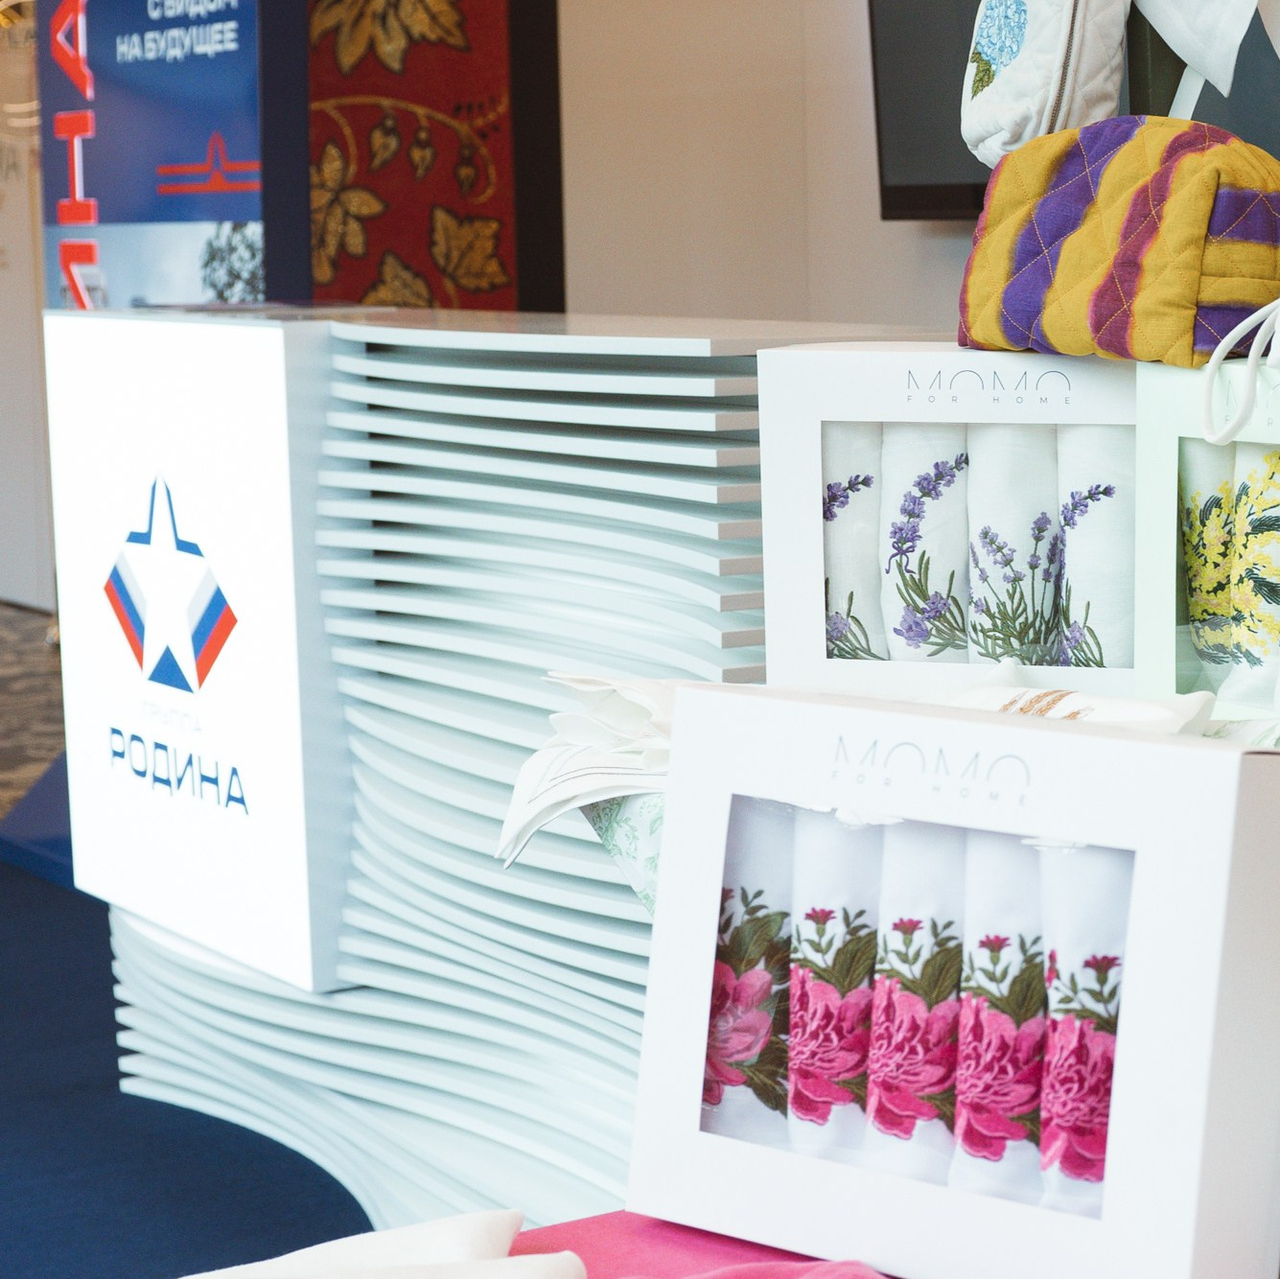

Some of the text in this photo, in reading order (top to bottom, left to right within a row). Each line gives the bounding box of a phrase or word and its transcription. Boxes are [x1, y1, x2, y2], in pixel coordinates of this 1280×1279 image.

[116, 20, 239, 63] НА БУДУЩЕЕ
[907, 369, 1071, 391] MOMO
[906, 395, 1071, 405] FOR HOME
[1224, 415, 1274, 427] FR
[109, 726, 249, 815] РОДИНА
[834, 734, 1031, 787] MOMO
